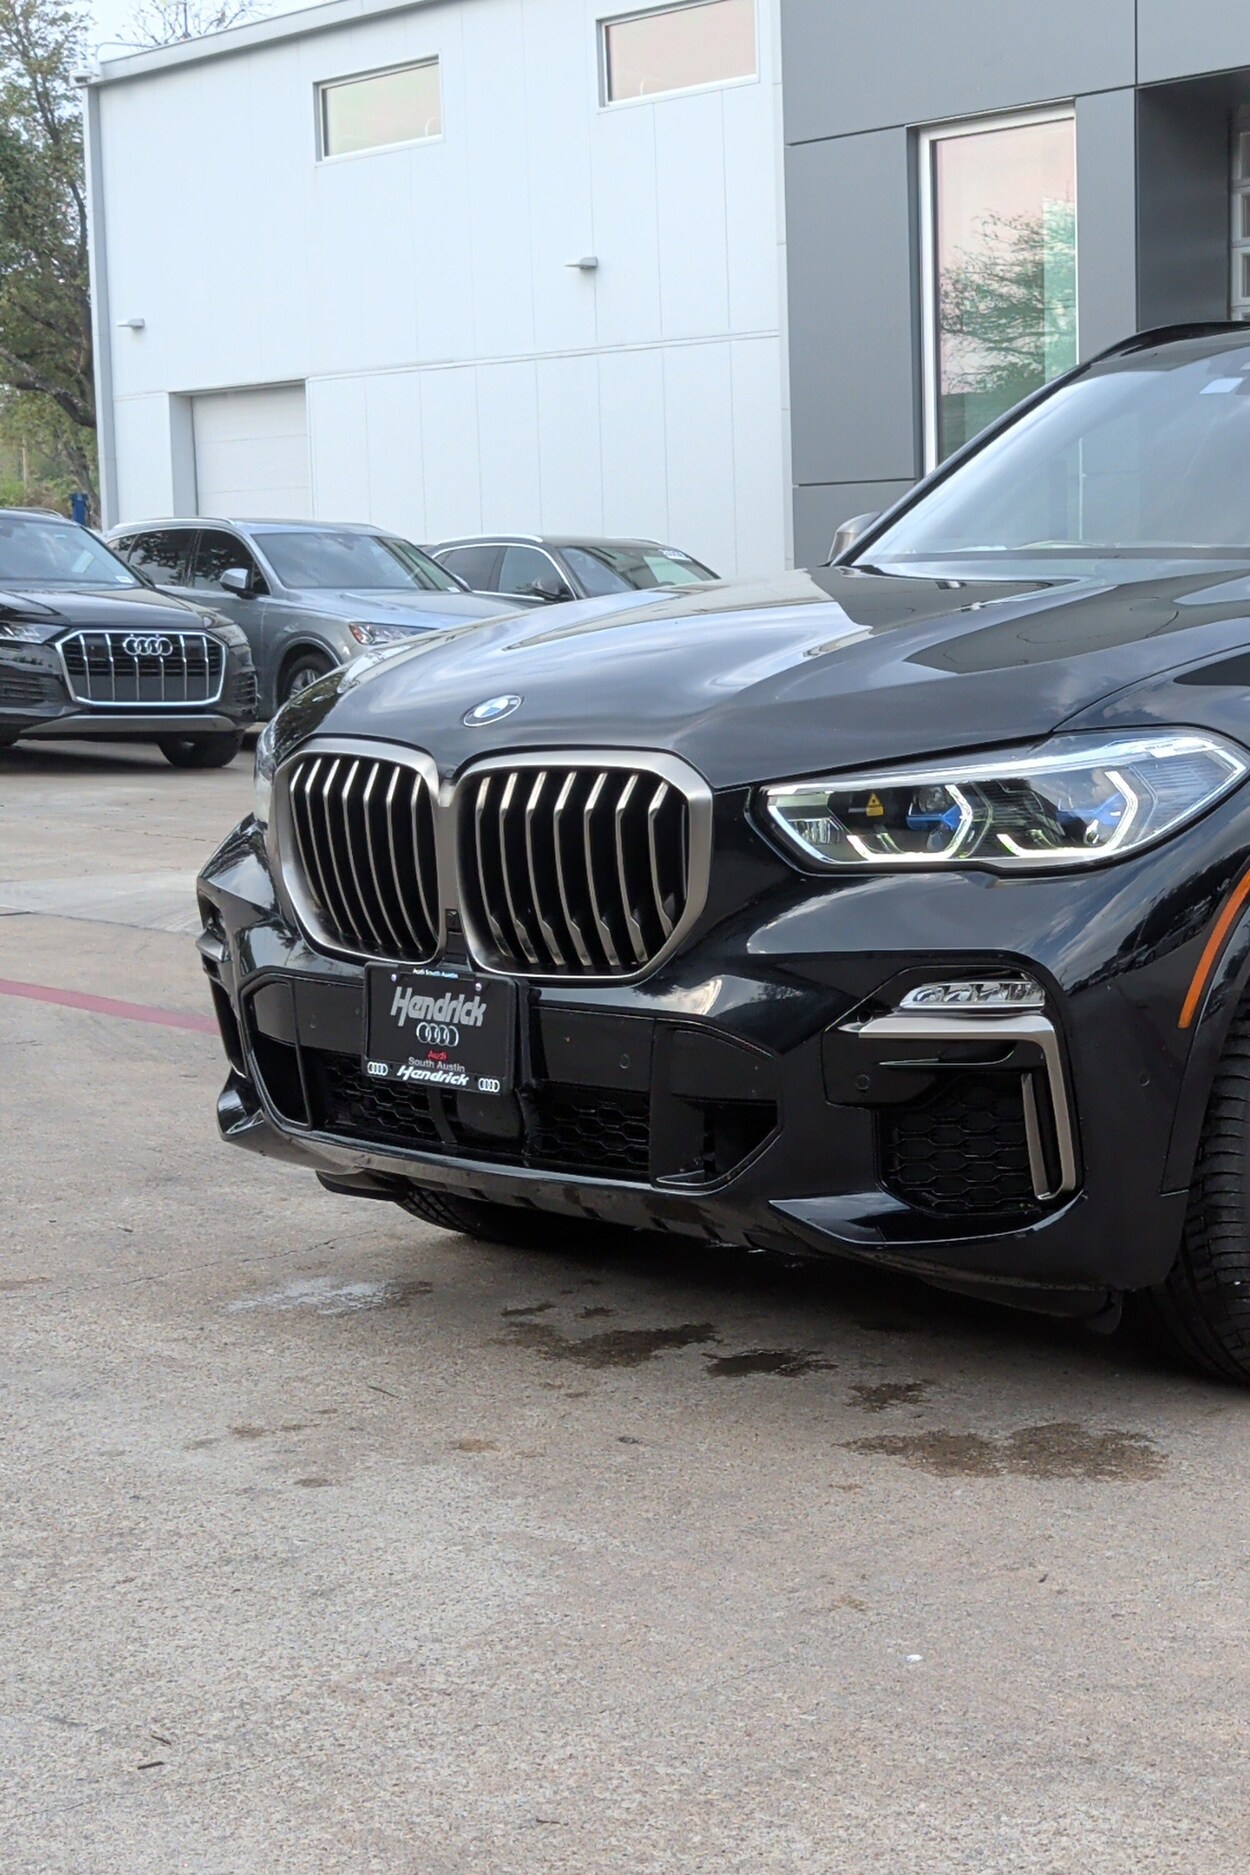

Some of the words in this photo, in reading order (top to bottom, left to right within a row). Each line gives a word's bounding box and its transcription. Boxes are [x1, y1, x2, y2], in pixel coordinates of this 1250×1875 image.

[390, 986, 487, 1027] Hendrick
[408, 1056, 435, 1069] South
[436, 1060, 466, 1074] Austin
[427, 1050, 448, 1060] Audi
[396, 1065, 470, 1087] Hendrick
